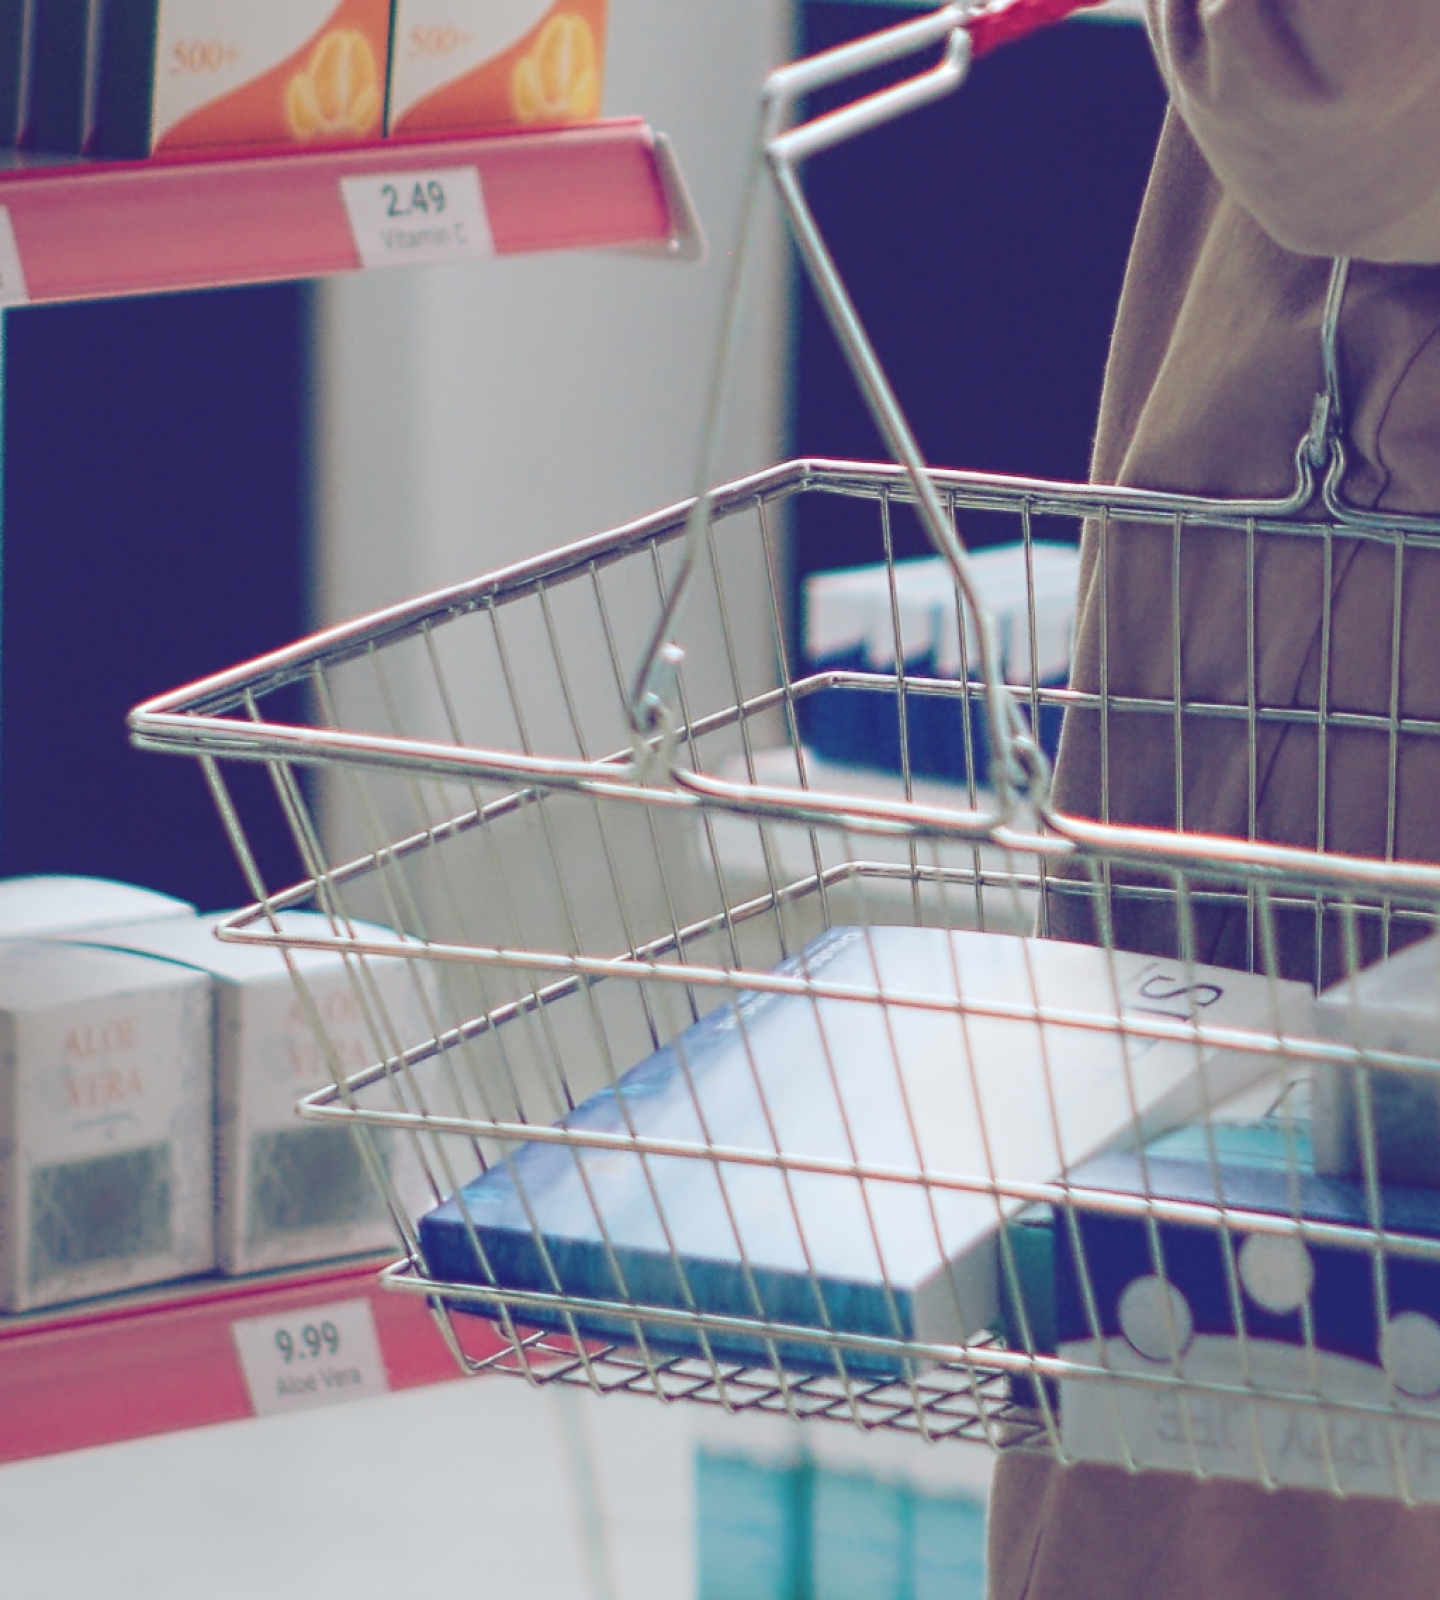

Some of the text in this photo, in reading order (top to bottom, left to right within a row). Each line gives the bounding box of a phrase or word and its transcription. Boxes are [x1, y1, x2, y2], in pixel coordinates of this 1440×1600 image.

[380, 180, 446, 218] 2.49
[453, 221, 469, 246] C
[65, 1015, 137, 1058] ALOE
[64, 1067, 144, 1109] VERA
[274, 1320, 340, 1365] 9.99
[276, 1366, 363, 1399] Aloe Vera
